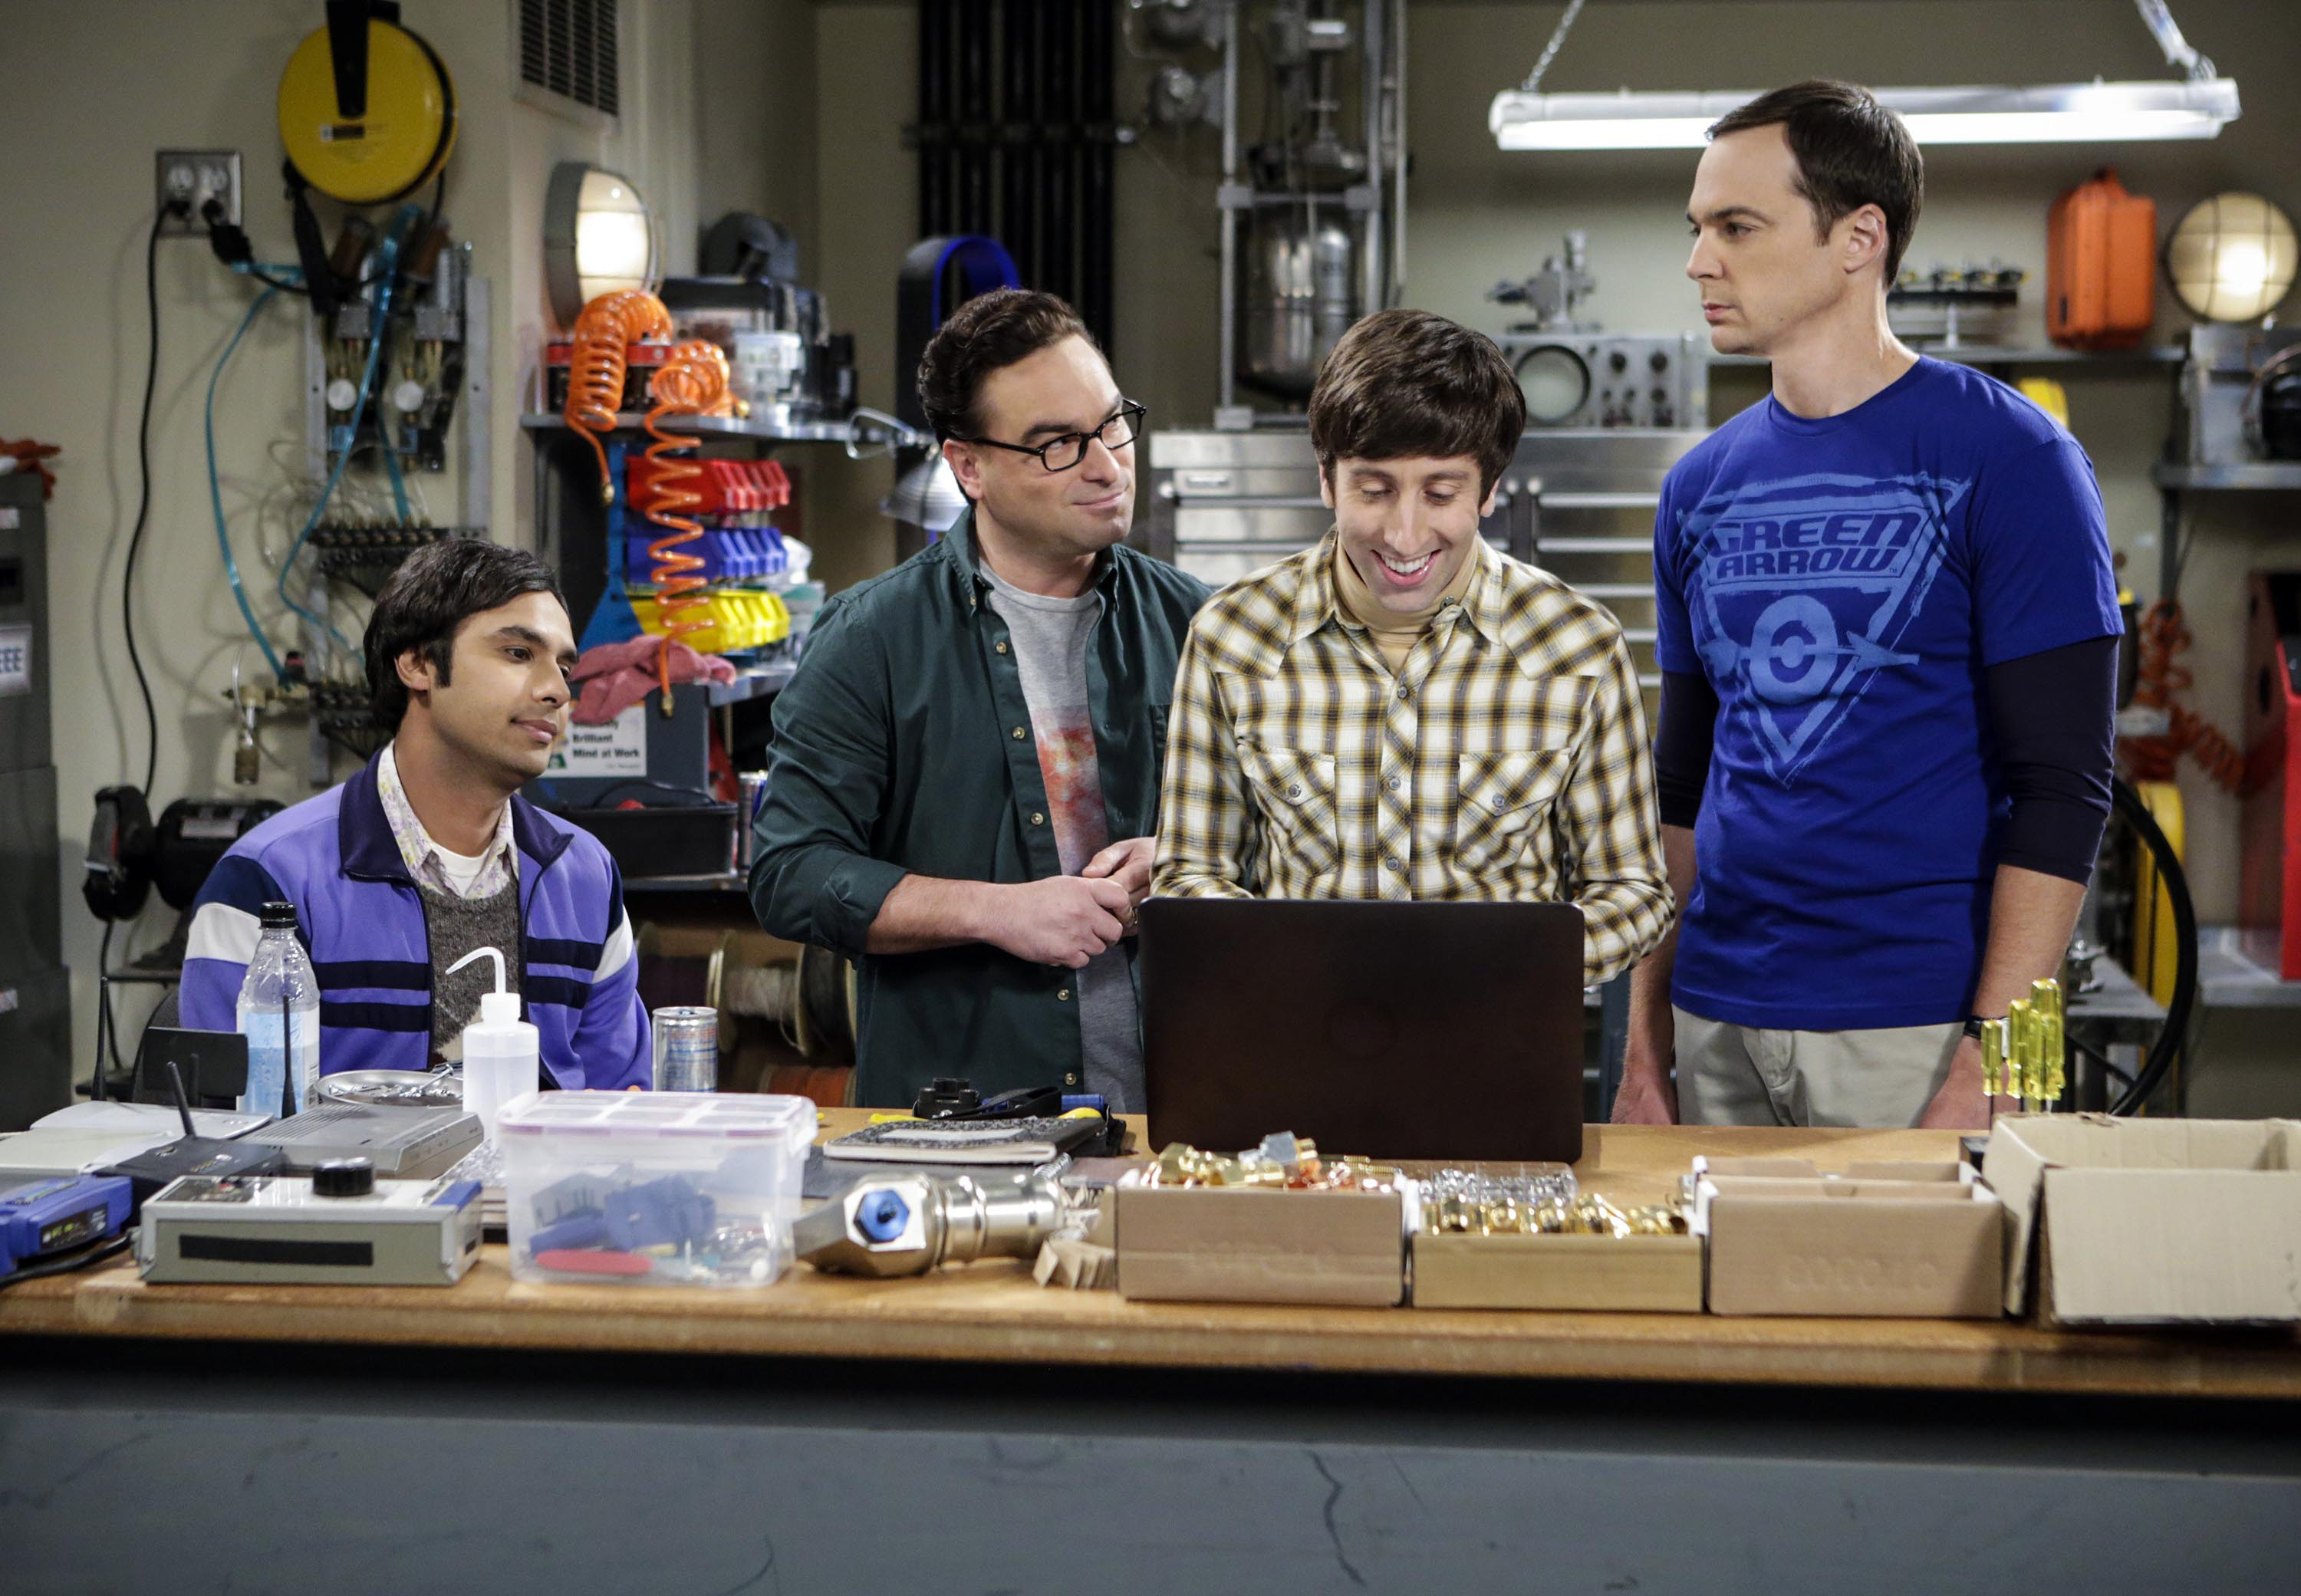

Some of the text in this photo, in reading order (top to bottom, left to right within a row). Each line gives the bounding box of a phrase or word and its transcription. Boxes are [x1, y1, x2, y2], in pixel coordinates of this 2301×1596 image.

[1707, 512, 1921, 558] GREEN
[1717, 547, 1901, 579] ARROW
[573, 734, 613, 743] Brilliant
[573, 749, 640, 758] Mind at Work
